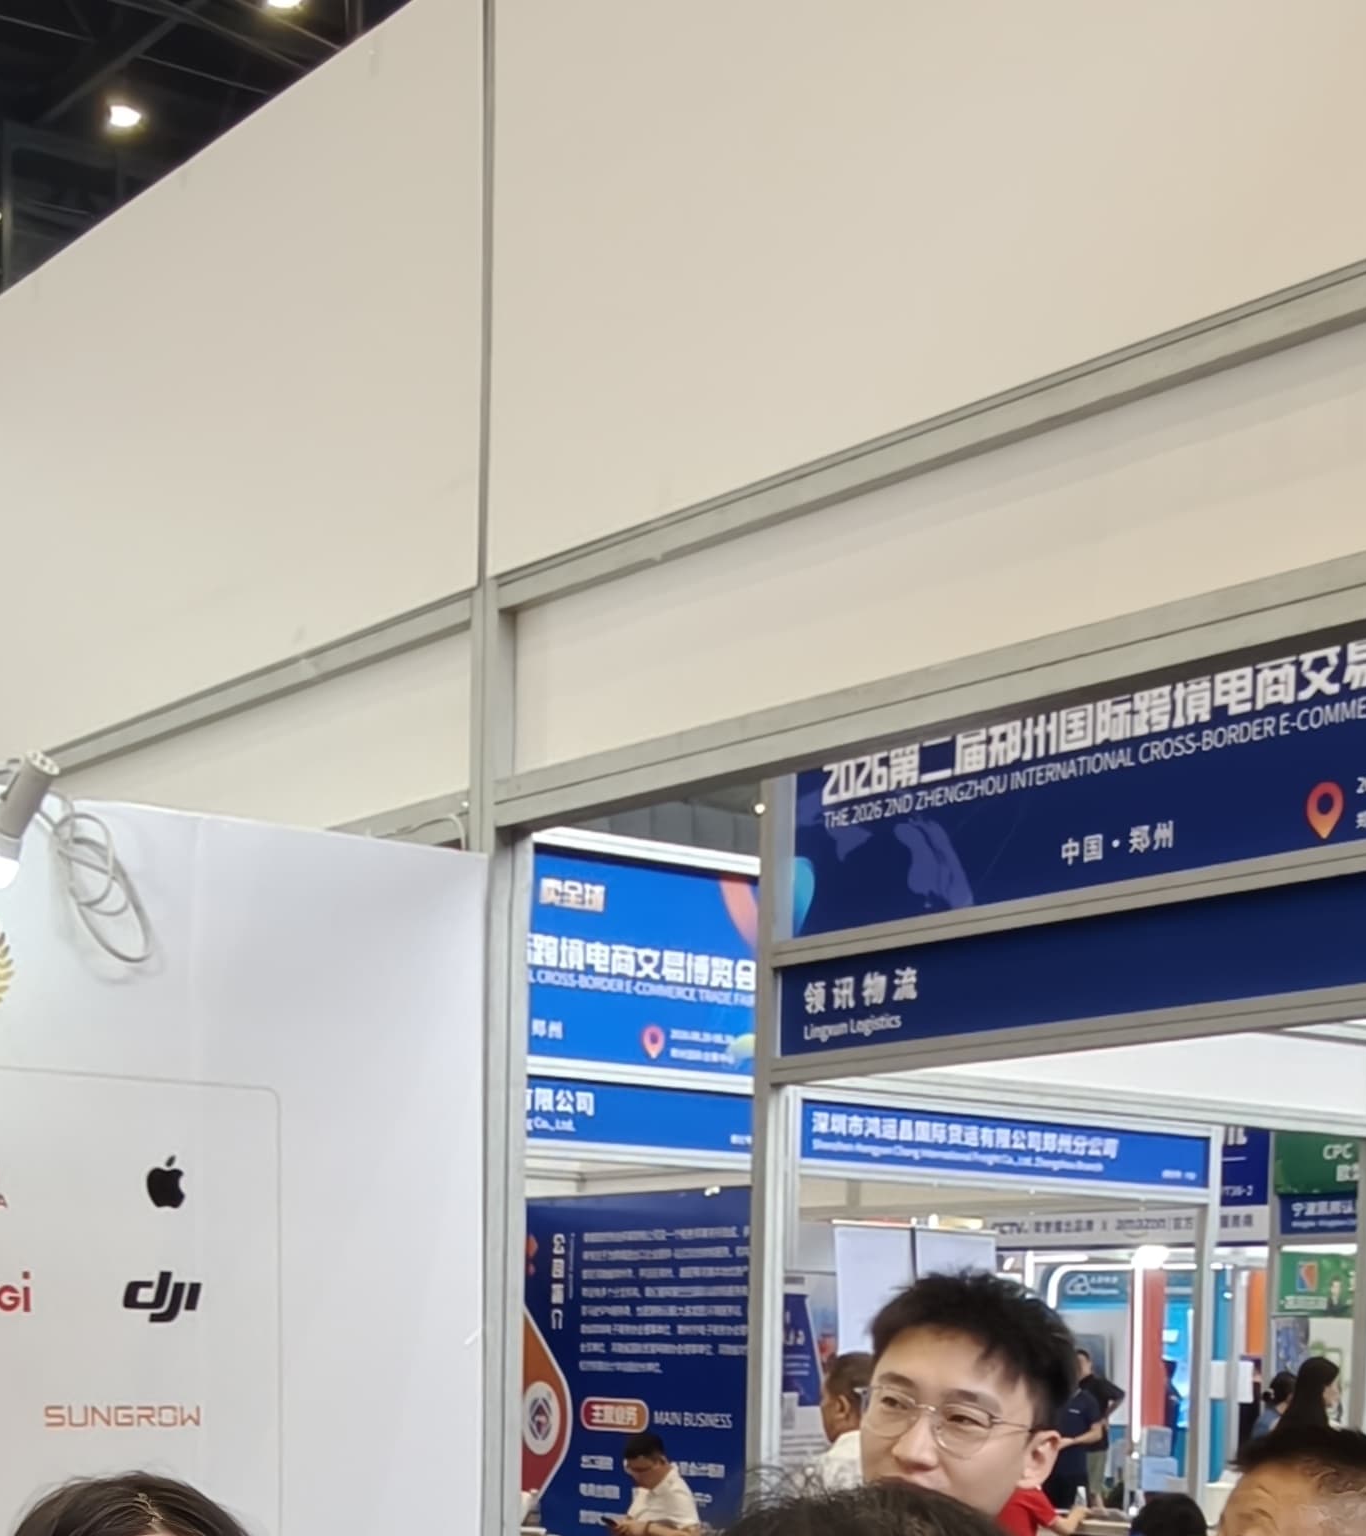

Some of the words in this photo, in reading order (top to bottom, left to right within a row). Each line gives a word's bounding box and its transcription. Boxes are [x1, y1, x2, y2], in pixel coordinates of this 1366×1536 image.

[823, 810, 849, 829] THE
[851, 801, 883, 823] 2026
[885, 794, 913, 818] 2ND
[915, 774, 1007, 811] ZHENGZHOU
[1010, 748, 1135, 789] INTERNATIONAL
[1138, 715, 1276, 765] CROSS-BORDER
[803, 966, 919, 1015] 领讯物流
[849, 1013, 903, 1037] Logistics
[43, 1404, 201, 1428] SUNGROW
[653, 1411, 682, 1427] MAIN
[683, 1412, 733, 1430] BUSINESS
